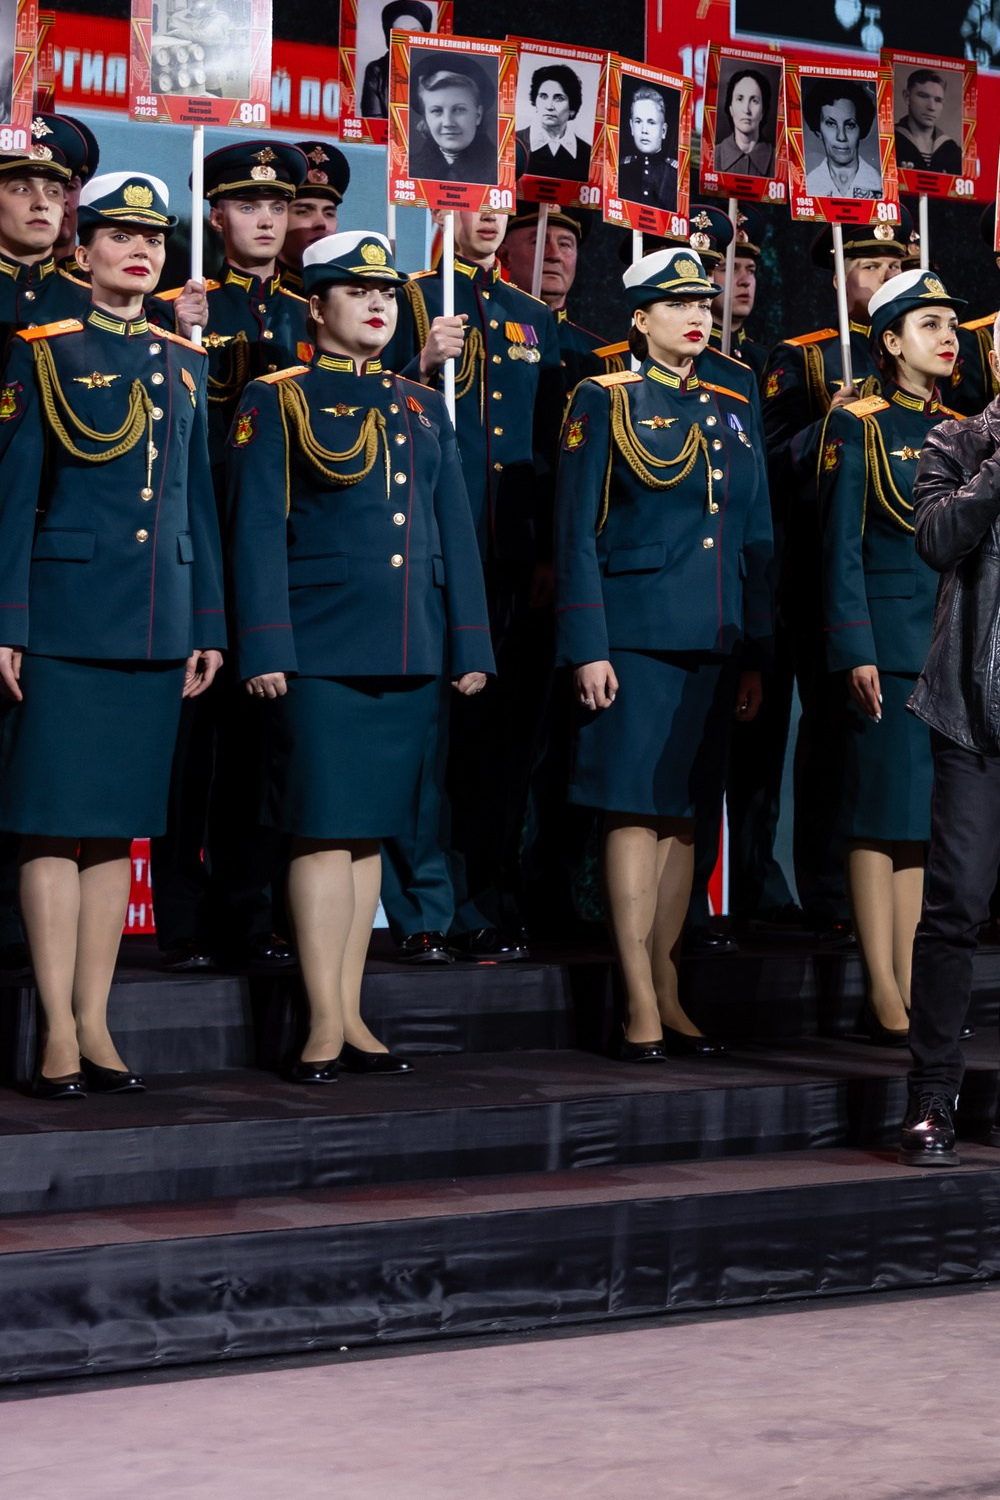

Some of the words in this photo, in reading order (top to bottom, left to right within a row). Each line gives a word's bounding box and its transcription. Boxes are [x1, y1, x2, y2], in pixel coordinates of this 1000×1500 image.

[409, 36, 438, 47] ЭНЕРГИЯ
[439, 38, 471, 51] ВЕЛИКОЙ
[471, 43, 501, 53] ПОБЕДЫ
[799, 65, 824, 74] ЭНЕРГИЯ
[825, 67, 852, 77] ВЕЛИКОЙ
[852, 69, 878, 78] ПОБЕДЫ
[135, 96, 158, 107] 1945
[134, 106, 158, 117] 2025
[240, 102, 266, 124] 80
[343, 118, 362, 129] 1945
[343, 129, 363, 138] 2025
[1, 128, 27, 152] 80
[395, 180, 415, 190] 1945
[768, 181, 785, 200] 80
[955, 178, 974, 196] 80
[394, 190, 416, 201] 2025
[489, 189, 512, 209] 80
[579, 186, 600, 205] 80
[608, 199, 622, 210] 1945
[796, 197, 814, 207] 1945
[608, 209, 623, 221] 2025
[796, 207, 815, 216] 2025
[877, 202, 898, 221] 80
[671, 216, 687, 235] 80
